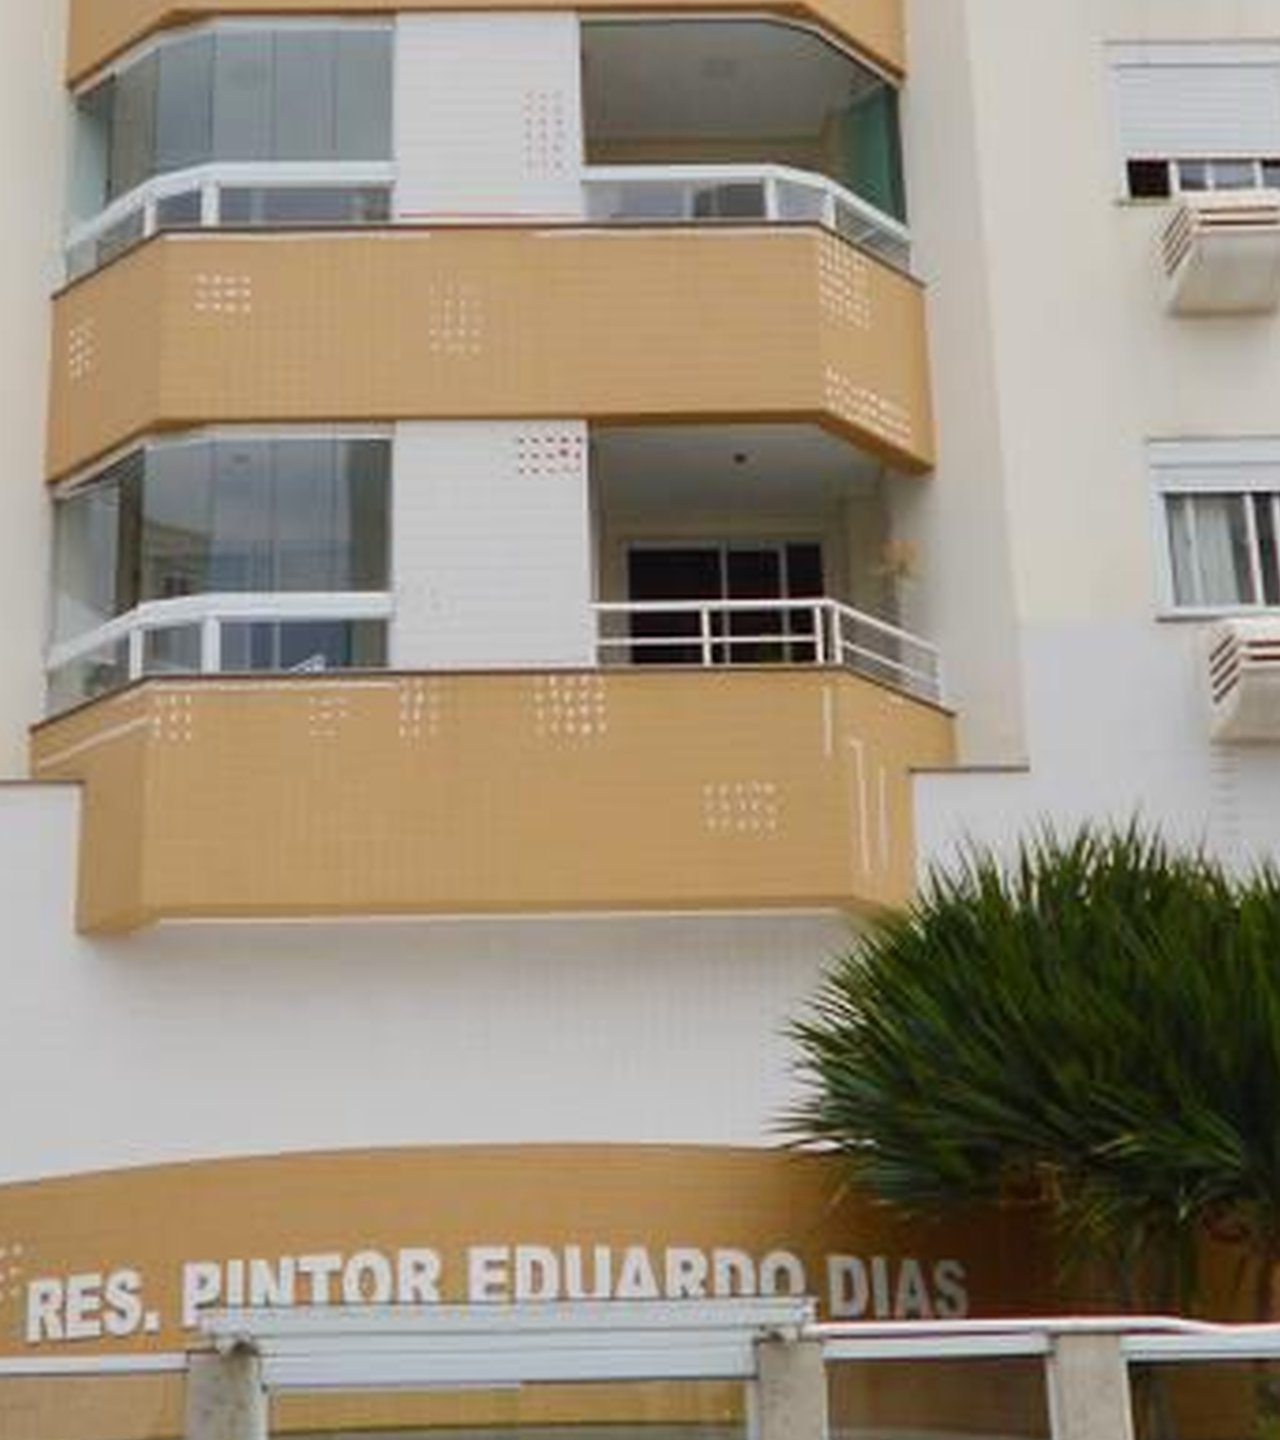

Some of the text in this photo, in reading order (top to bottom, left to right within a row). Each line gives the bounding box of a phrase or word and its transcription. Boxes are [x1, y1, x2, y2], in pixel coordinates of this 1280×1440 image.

[26, 1245, 969, 1343] RES. PINTOR EDUARDO DIAS
